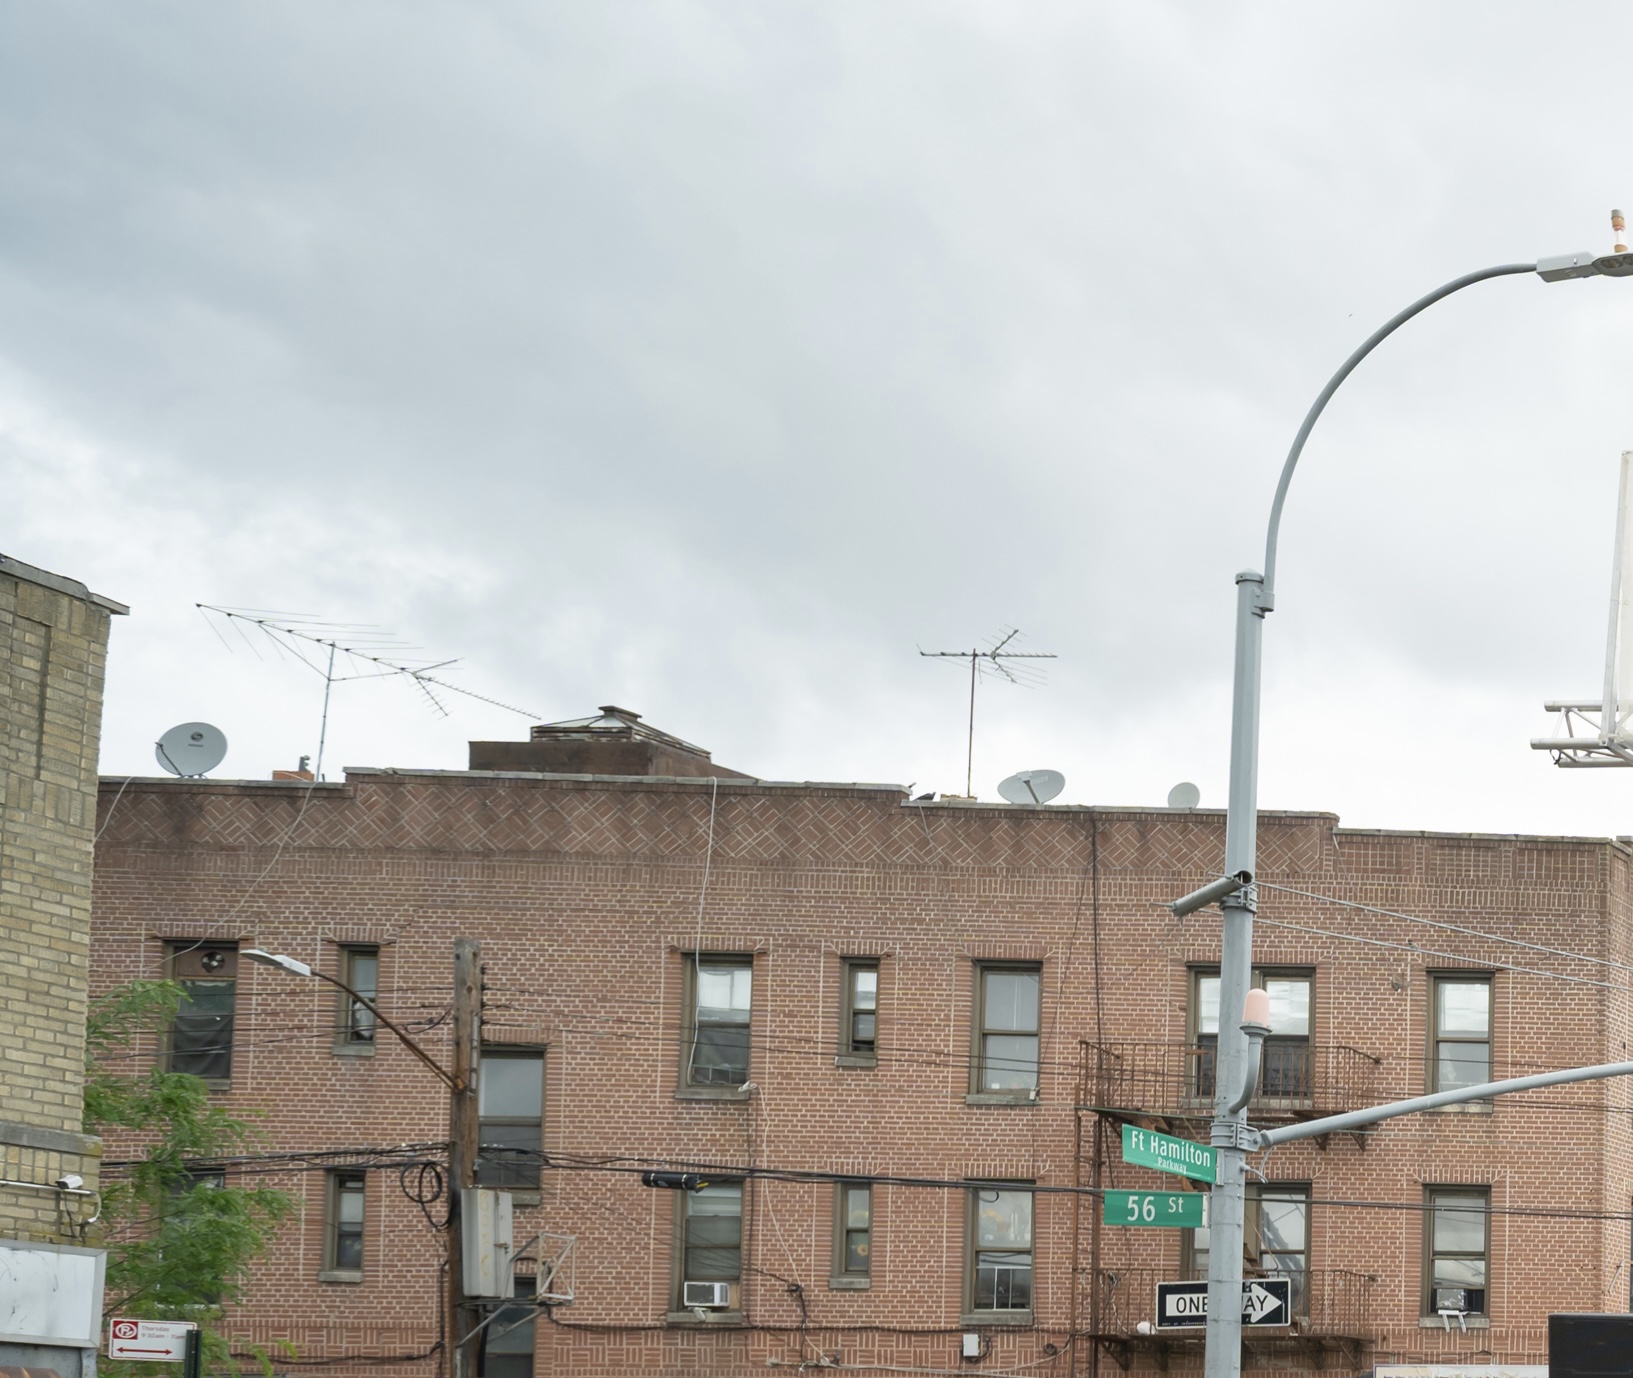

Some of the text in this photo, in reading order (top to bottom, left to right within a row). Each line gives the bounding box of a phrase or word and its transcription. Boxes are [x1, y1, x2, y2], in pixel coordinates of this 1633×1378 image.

[1131, 1130, 1211, 1168] Ft Hamilton
[1157, 1158, 1187, 1175] Parkway
[1127, 1195, 1184, 1222] 56 St
[1243, 1294, 1269, 1312] AY
